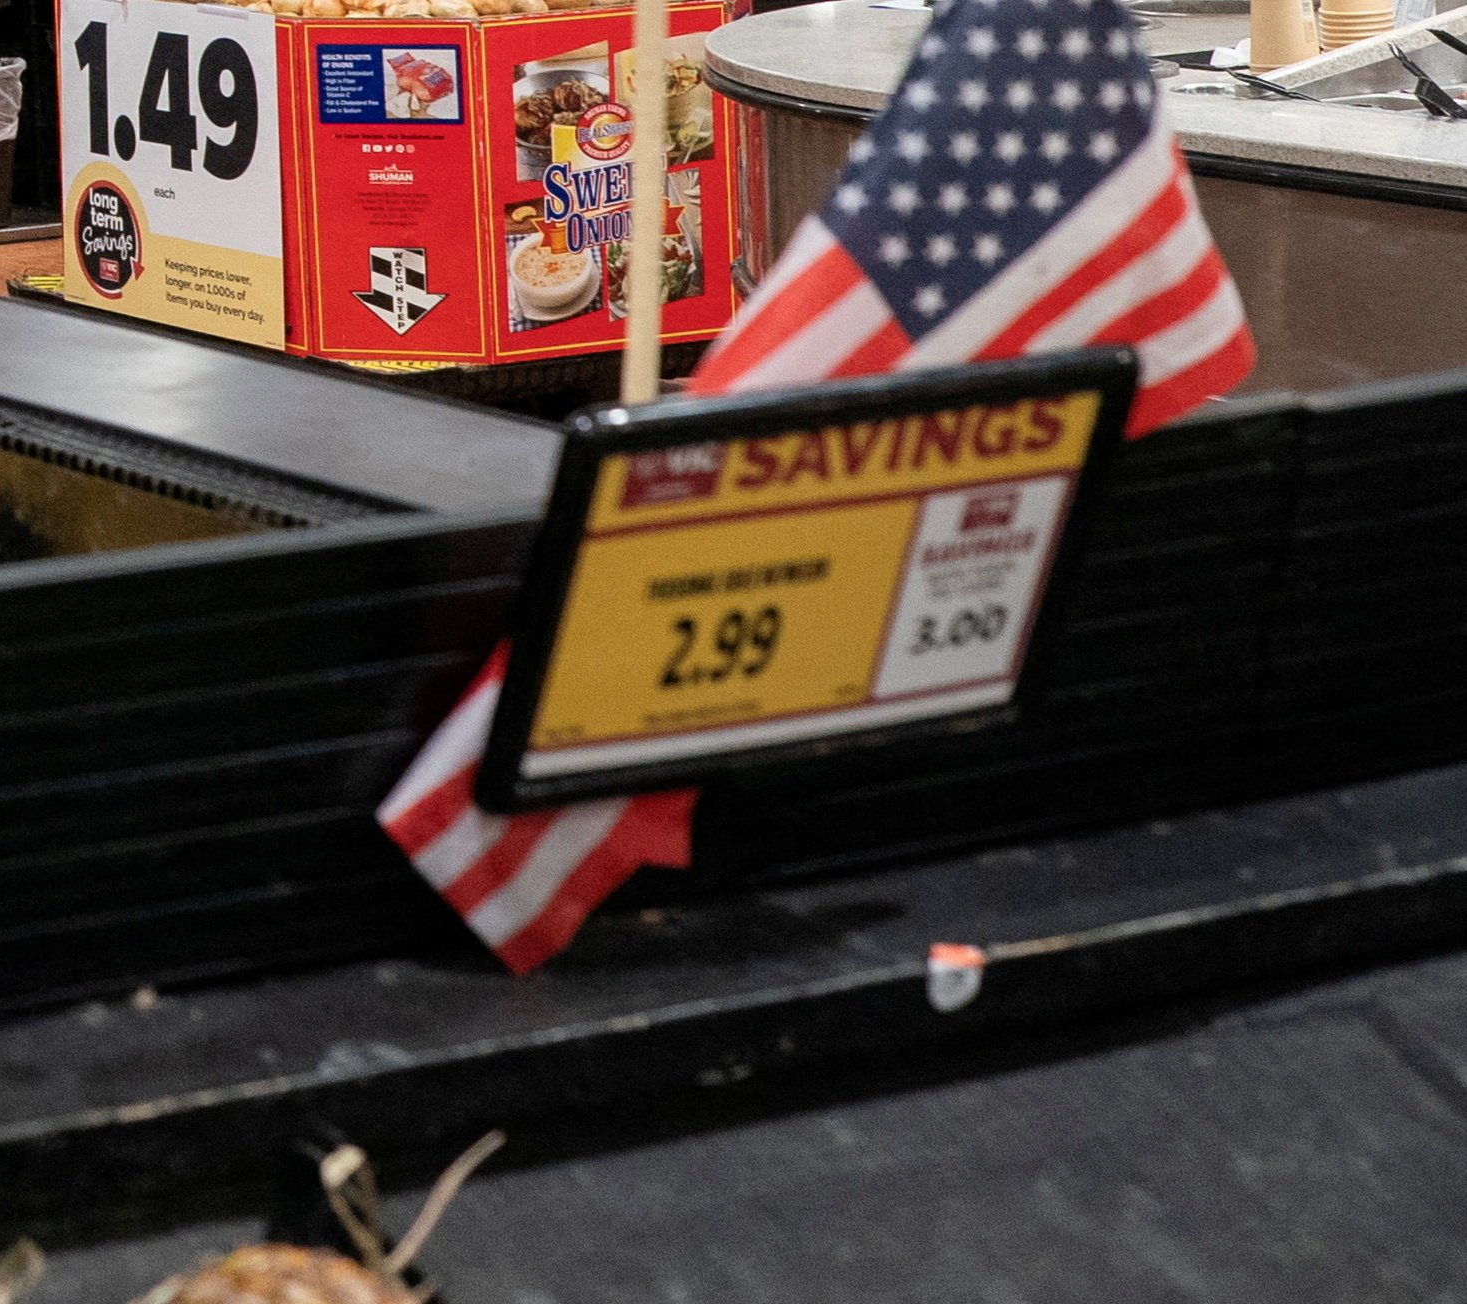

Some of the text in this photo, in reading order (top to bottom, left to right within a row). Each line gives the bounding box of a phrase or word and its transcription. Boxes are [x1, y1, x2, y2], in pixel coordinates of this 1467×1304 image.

[74, 20, 258, 181] 1.49
[369, 173, 413, 181] SHUMAN
[88, 187, 119, 216] long
[154, 188, 176, 201] each
[91, 207, 124, 232] term
[82, 225, 134, 260] Savings
[164, 258, 252, 286] Keeping prices lower,
[165, 275, 193, 294] longer,
[194, 281, 205, 292] on
[237, 289, 246, 301] of
[392, 252, 405, 329] WATCH STEP
[166, 292, 265, 324] items you buy every day.
[735, 394, 1069, 490] SAVINGS
[911, 601, 1008, 657] 3.00
[659, 602, 782, 690] 2.99
